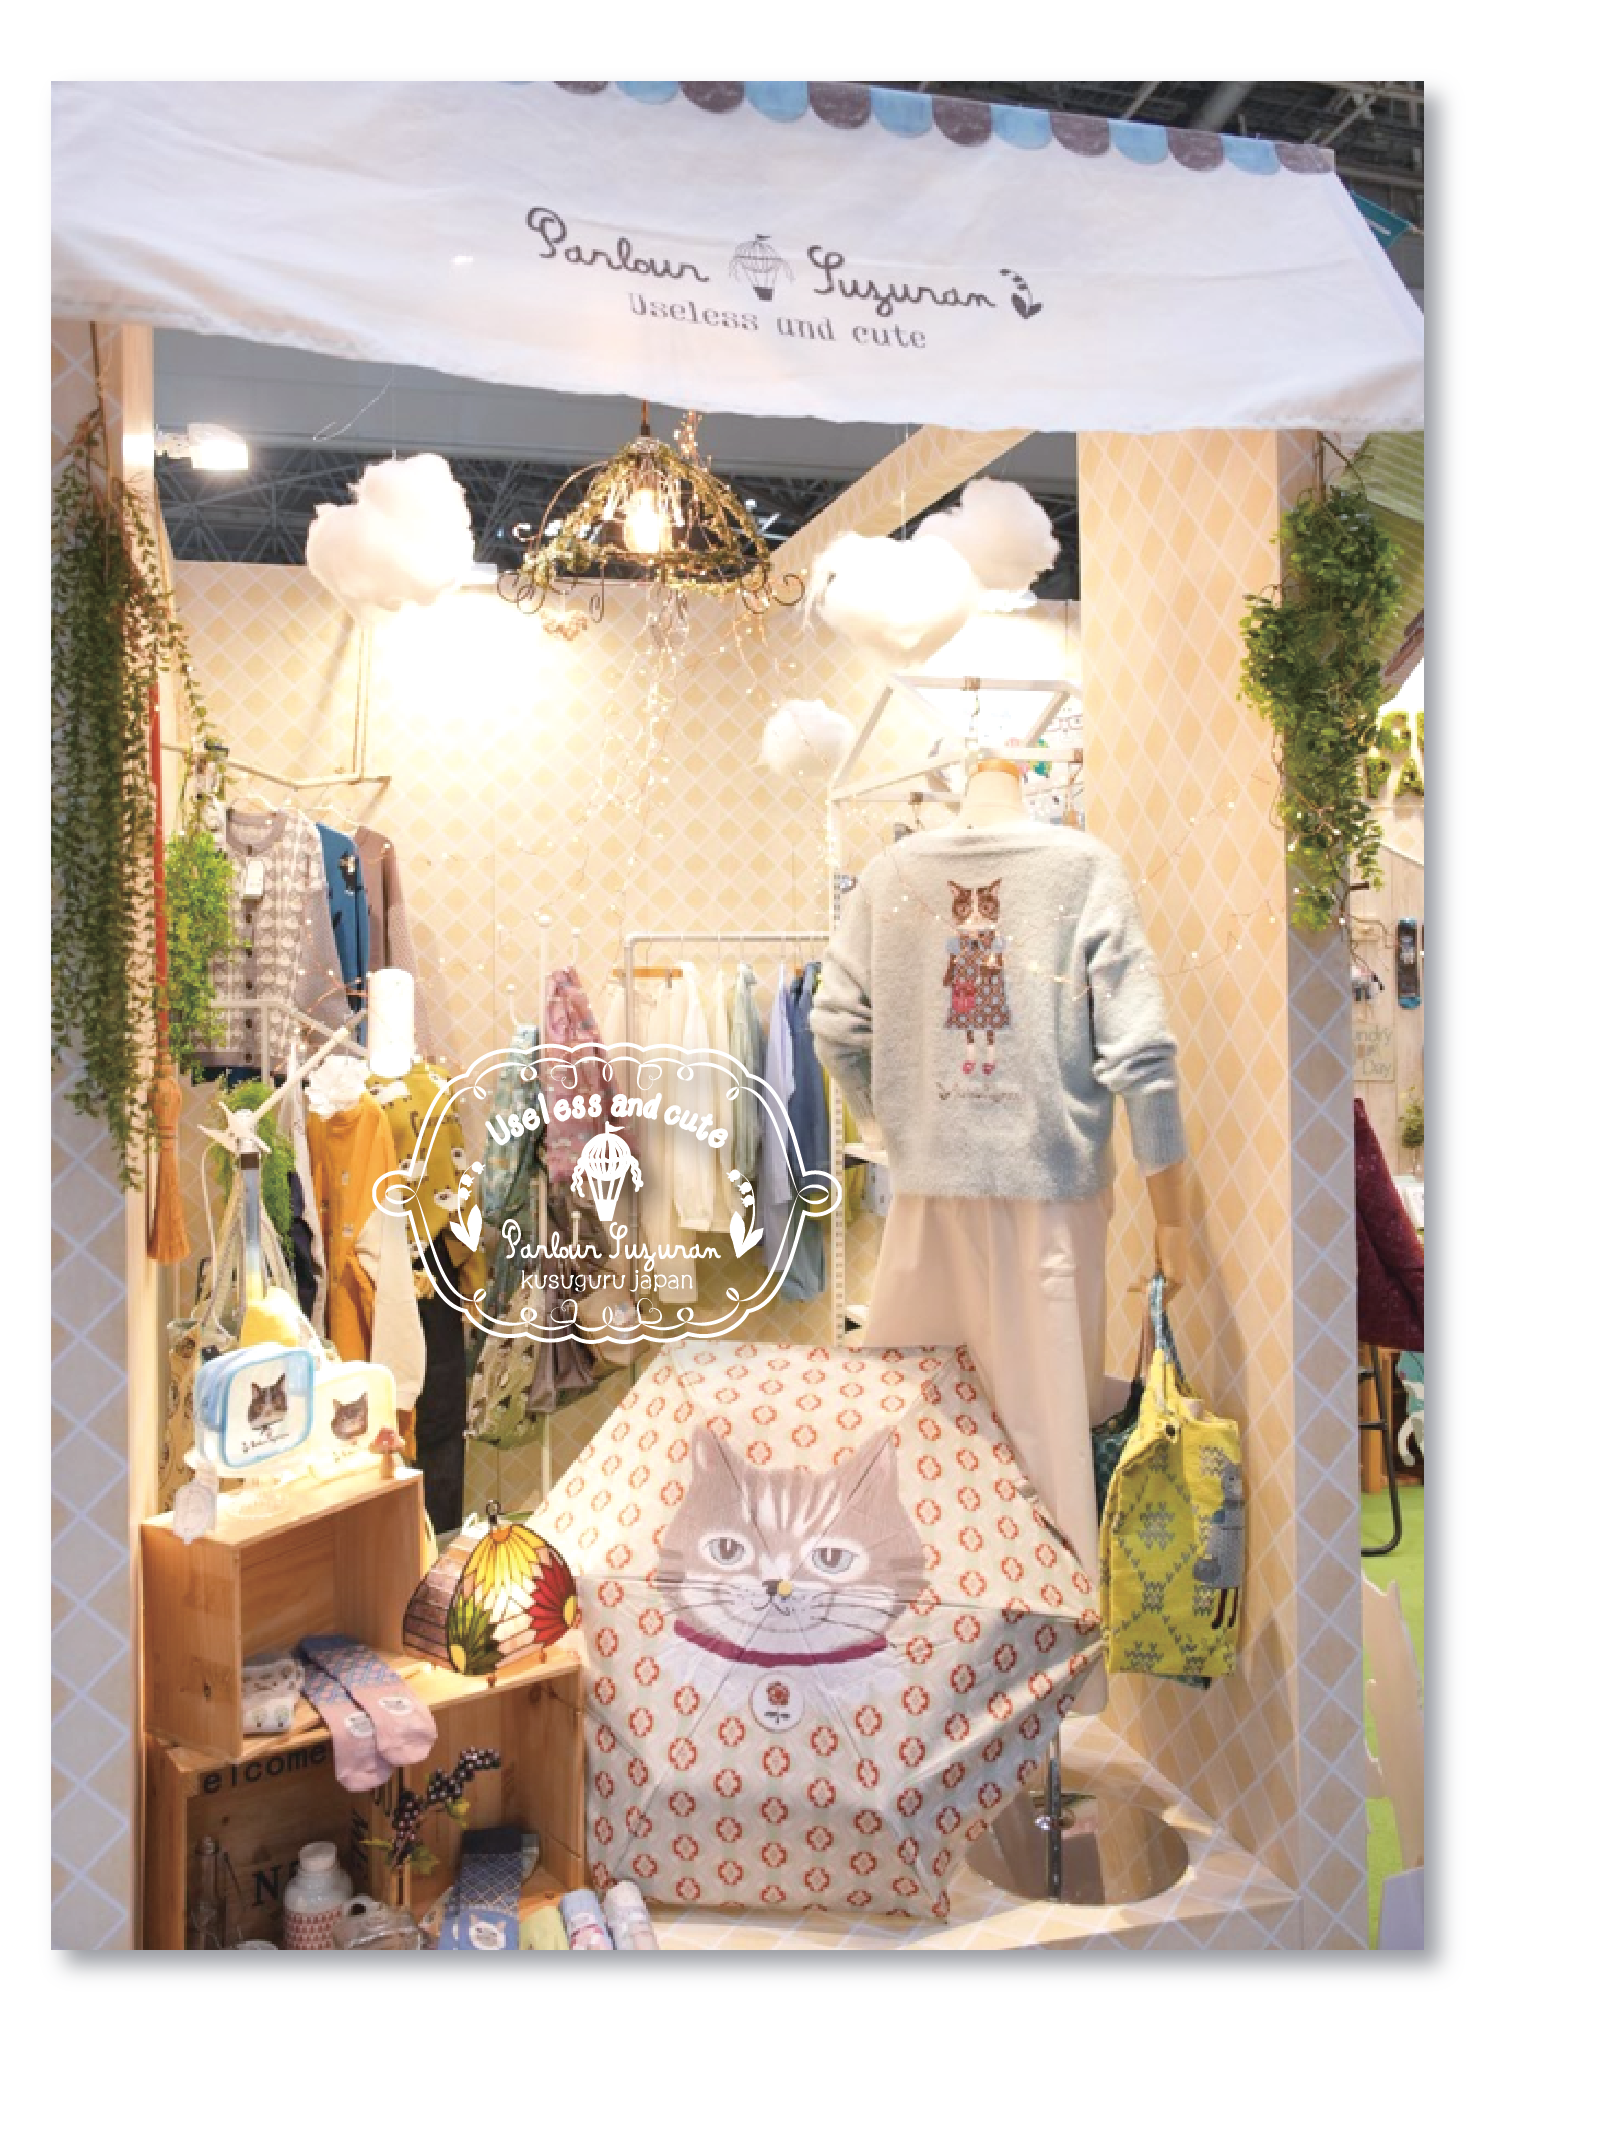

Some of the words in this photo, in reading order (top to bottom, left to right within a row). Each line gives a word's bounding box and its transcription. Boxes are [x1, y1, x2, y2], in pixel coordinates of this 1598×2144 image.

[525, 206, 710, 284] Parlour
[806, 244, 996, 318] Suzuran
[629, 291, 759, 331] Useless
[852, 324, 927, 349] cute
[203, 1744, 327, 1794] elcome
